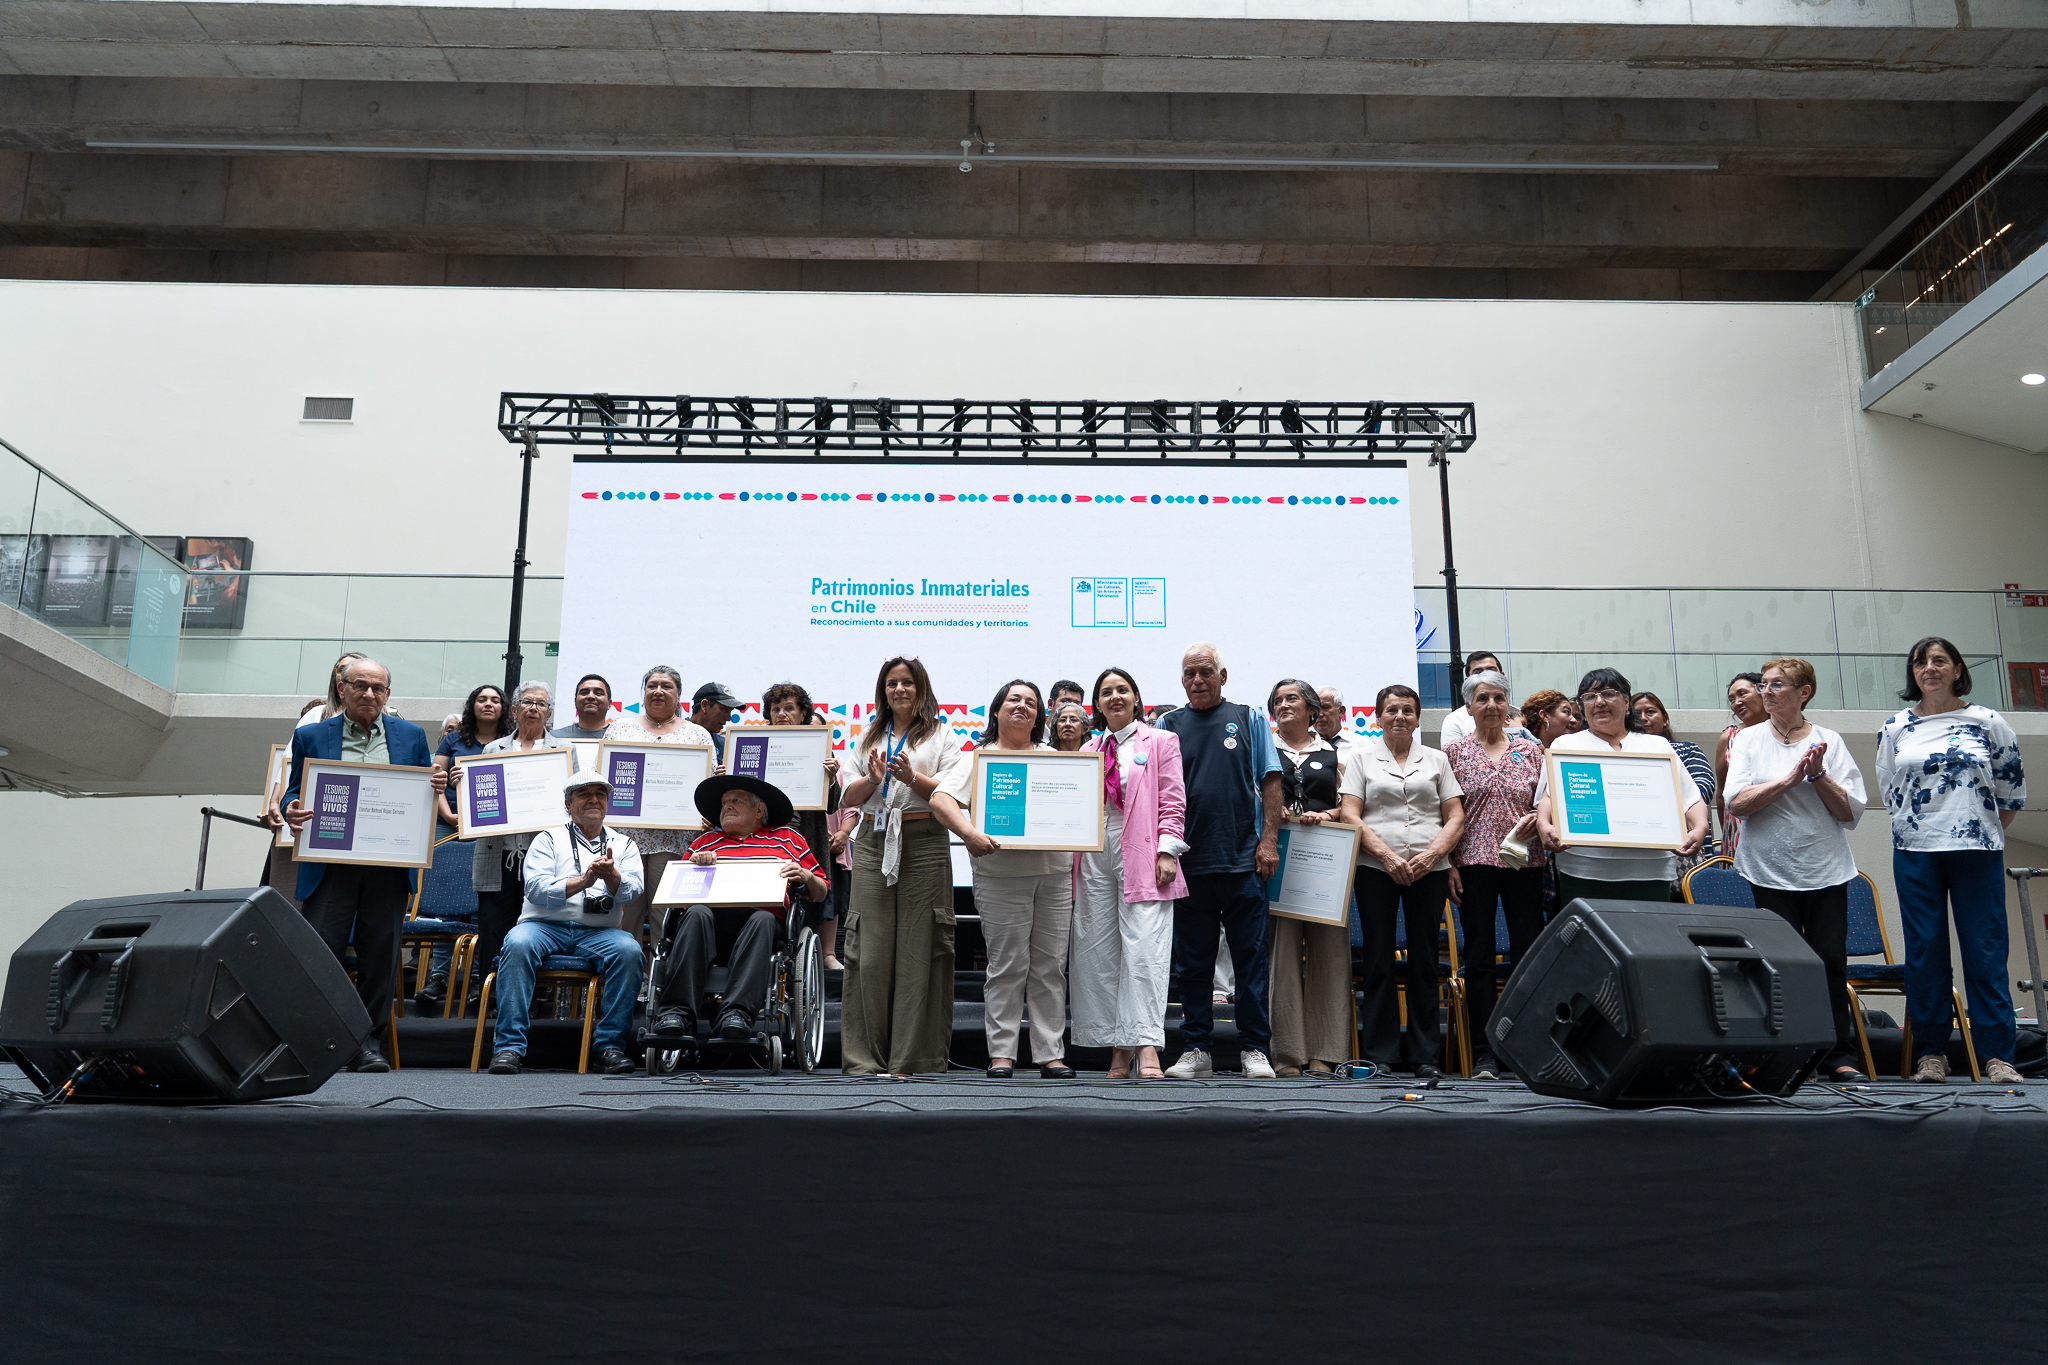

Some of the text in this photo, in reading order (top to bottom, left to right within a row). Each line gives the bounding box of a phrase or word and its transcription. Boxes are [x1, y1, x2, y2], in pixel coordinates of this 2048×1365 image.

[811, 577, 1030, 596] Patrimonios Inmateriales
[811, 600, 876, 614] en Chile
[810, 618, 885, 626] Reconocimiento
[912, 618, 974, 626] comunidades
[976, 620, 982, 628] y
[984, 619, 1028, 627] territorios
[742, 745, 762, 753] TESOROS
[616, 761, 637, 770] TESOROS
[740, 760, 760, 768] VIVOS
[475, 774, 497, 783] TESOROS
[615, 776, 636, 785] VIVOS
[325, 784, 350, 795] TESOROS
[476, 782, 497, 790] HUMANOS
[476, 788, 498, 798] VIVOS
[323, 794, 349, 804] HUMANOS
[323, 803, 348, 813] VIVOS
